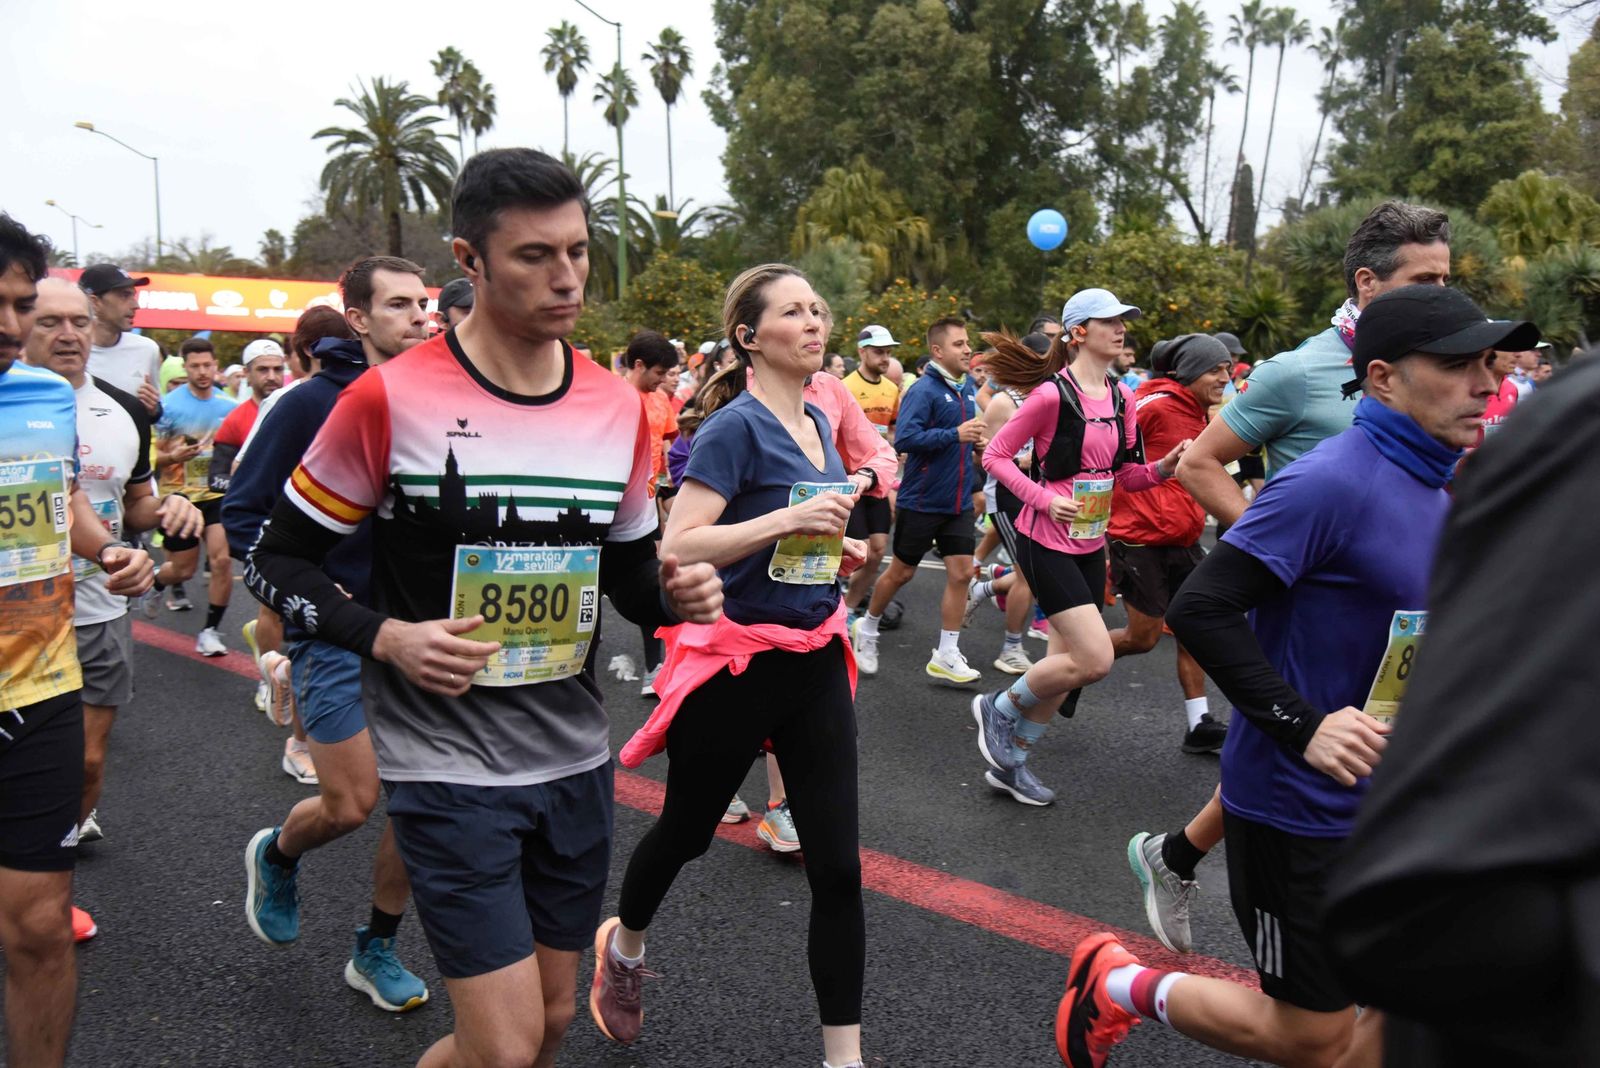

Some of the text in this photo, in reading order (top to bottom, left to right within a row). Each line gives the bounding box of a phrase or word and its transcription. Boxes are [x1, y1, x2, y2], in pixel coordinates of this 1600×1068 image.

[524, 561, 561, 571] sevilla
[479, 583, 569, 624] 8580
[503, 625, 548, 636] Manu Quero
[503, 671, 524, 680] HOKA
